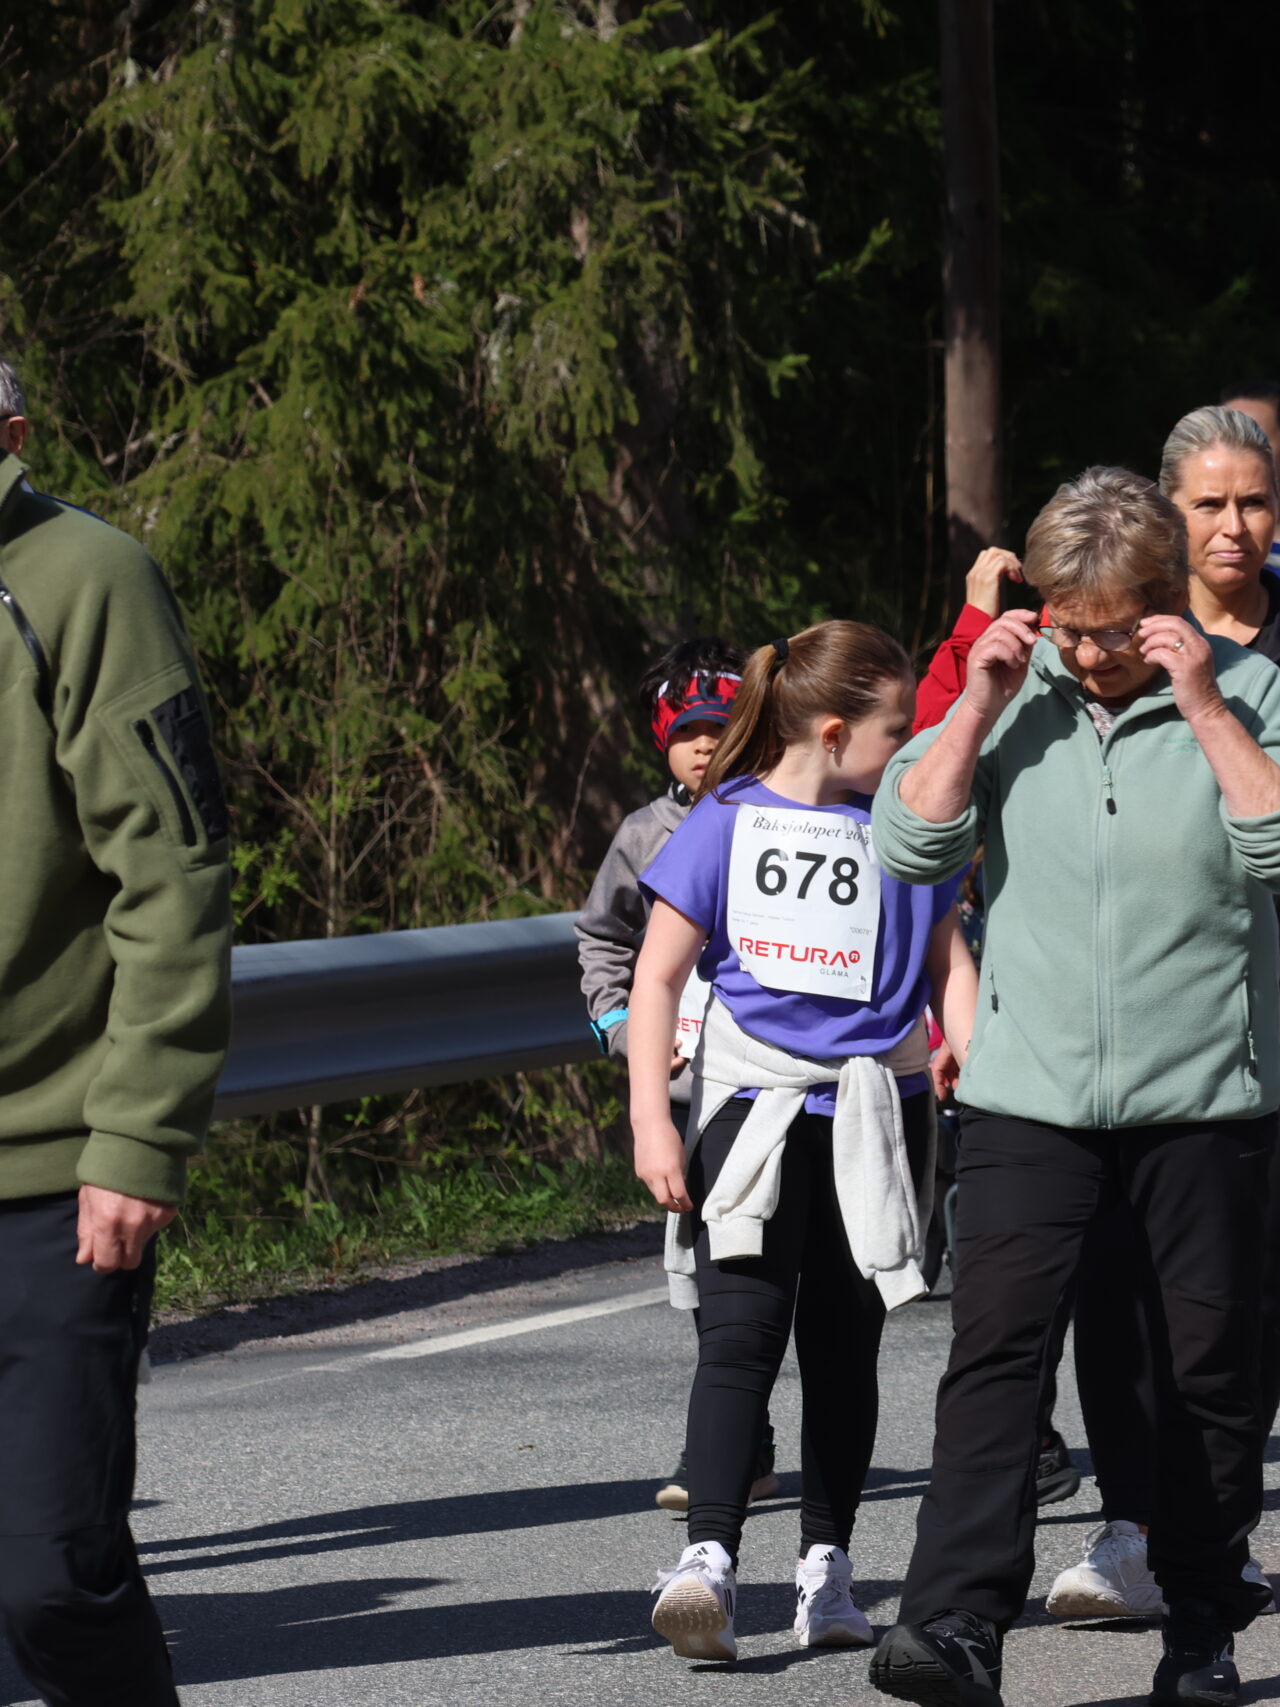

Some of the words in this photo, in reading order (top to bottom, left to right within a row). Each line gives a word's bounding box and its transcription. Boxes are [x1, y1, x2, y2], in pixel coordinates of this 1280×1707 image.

[752, 816, 841, 839] Baksjøløpet
[756, 848, 860, 906] 678
[739, 936, 849, 969] RETURA
